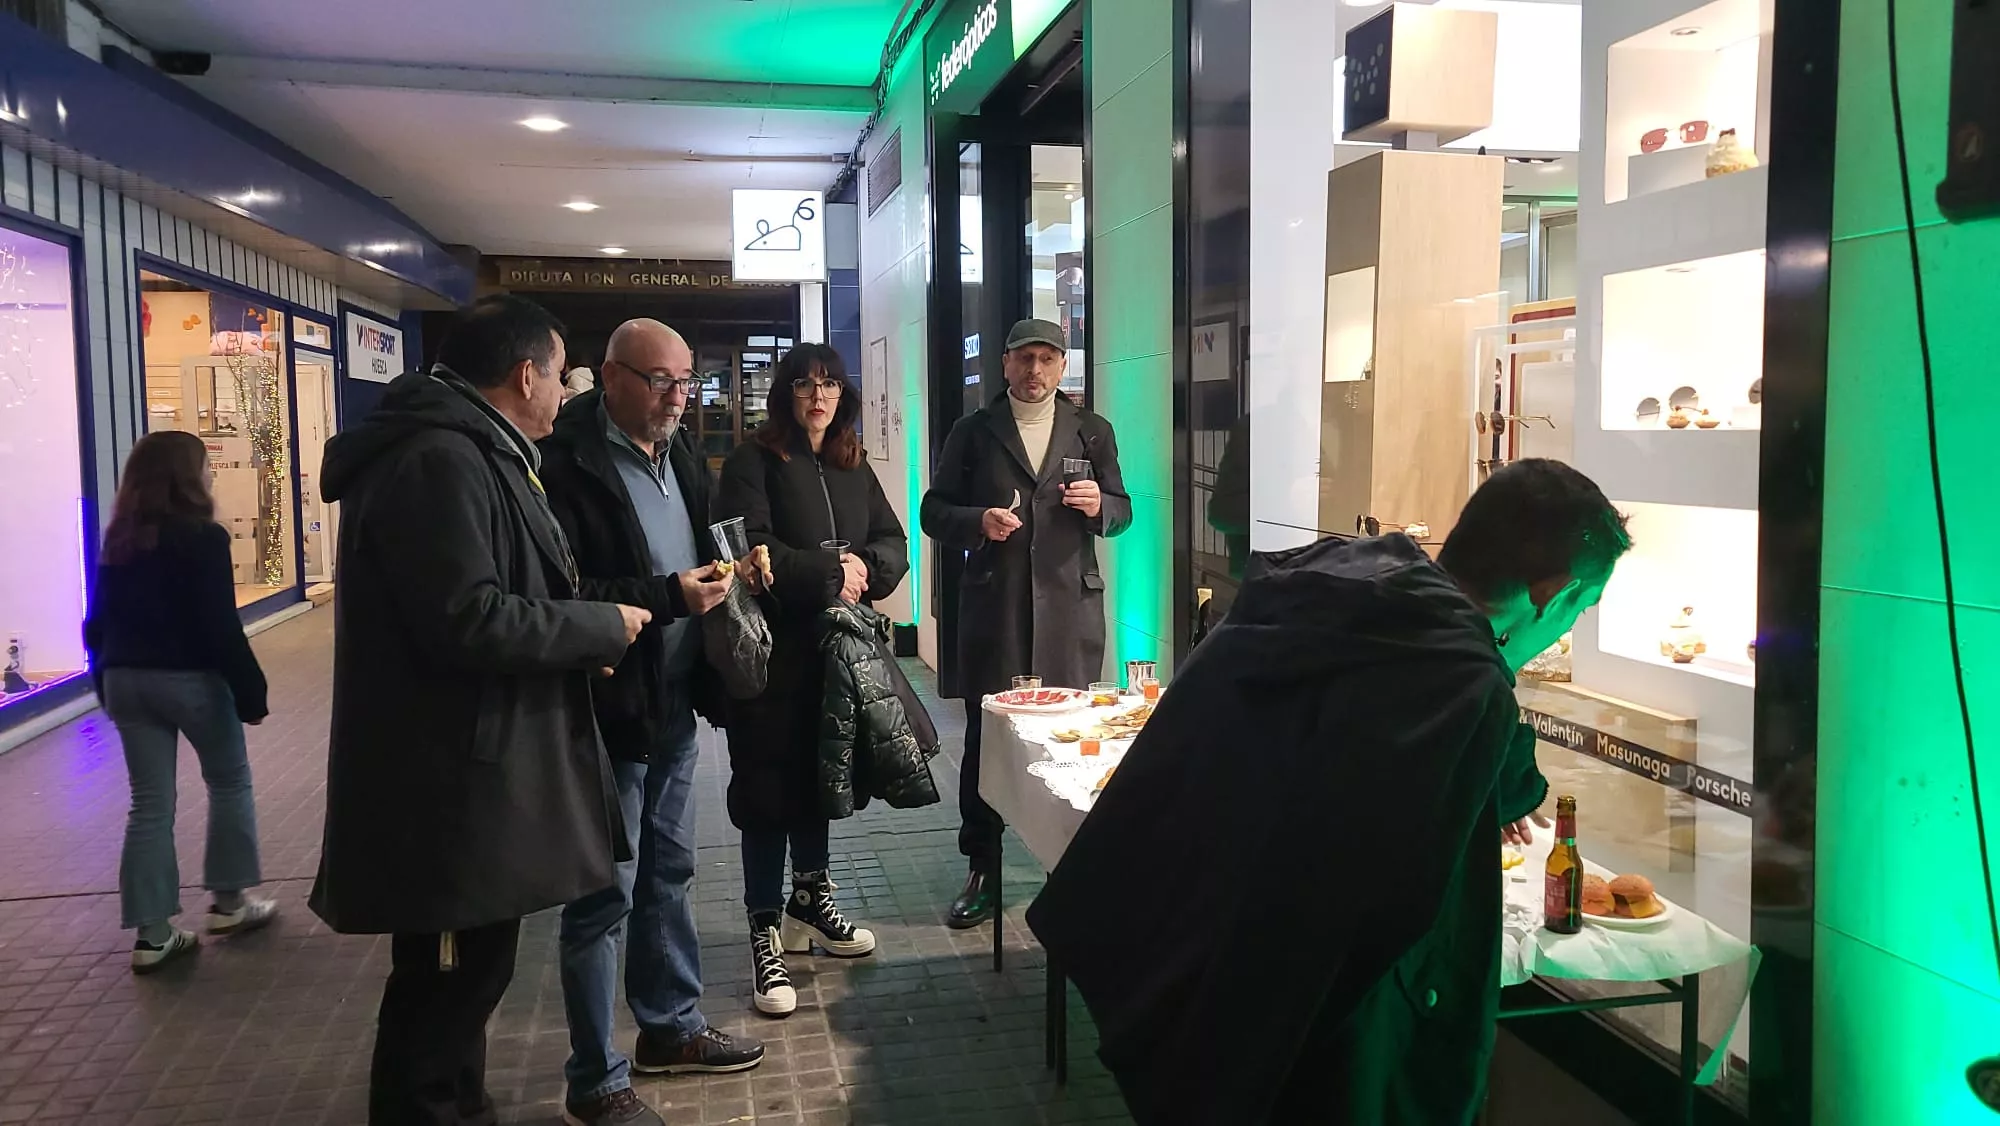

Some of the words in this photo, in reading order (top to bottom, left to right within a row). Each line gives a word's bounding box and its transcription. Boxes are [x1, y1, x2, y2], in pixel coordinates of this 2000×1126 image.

[942, 0, 998, 93] federópticos
[630, 273, 699, 287] GENERAL
[711, 274, 729, 287] DE
[364, 326, 395, 356] INTERSPORT
[372, 357, 387, 375] HUESCA
[1596, 732, 1671, 780] Masunaga
[1686, 765, 1752, 808] Porsche
